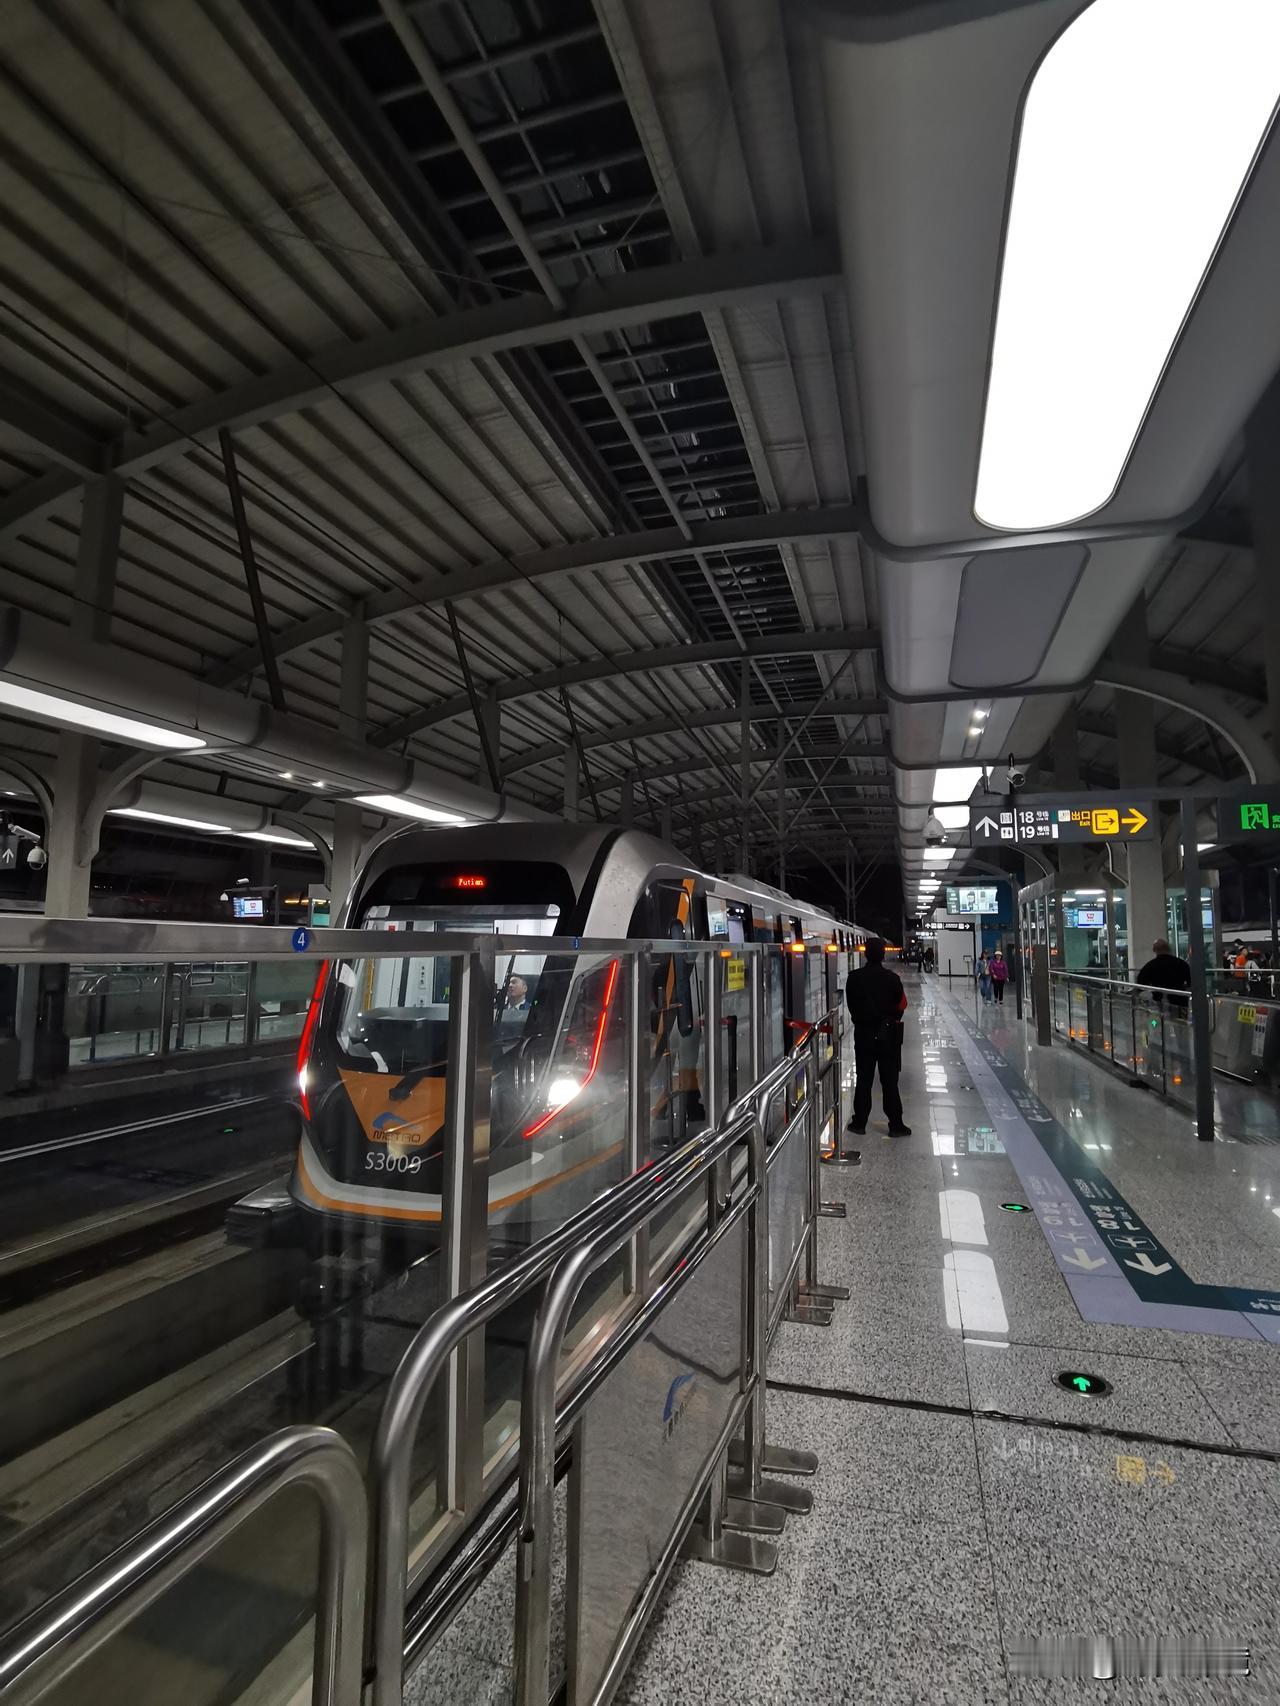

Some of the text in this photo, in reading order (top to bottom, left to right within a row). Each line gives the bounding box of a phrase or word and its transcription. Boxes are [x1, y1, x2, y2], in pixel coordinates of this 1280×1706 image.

[1019, 811, 1034, 824] 18
[1071, 811, 1091, 821] 出口
[1020, 825, 1035, 839] 19
[297, 932, 305, 947] 4
[364, 1151, 422, 1174] S3009
[1097, 1219, 1141, 1231] 18
